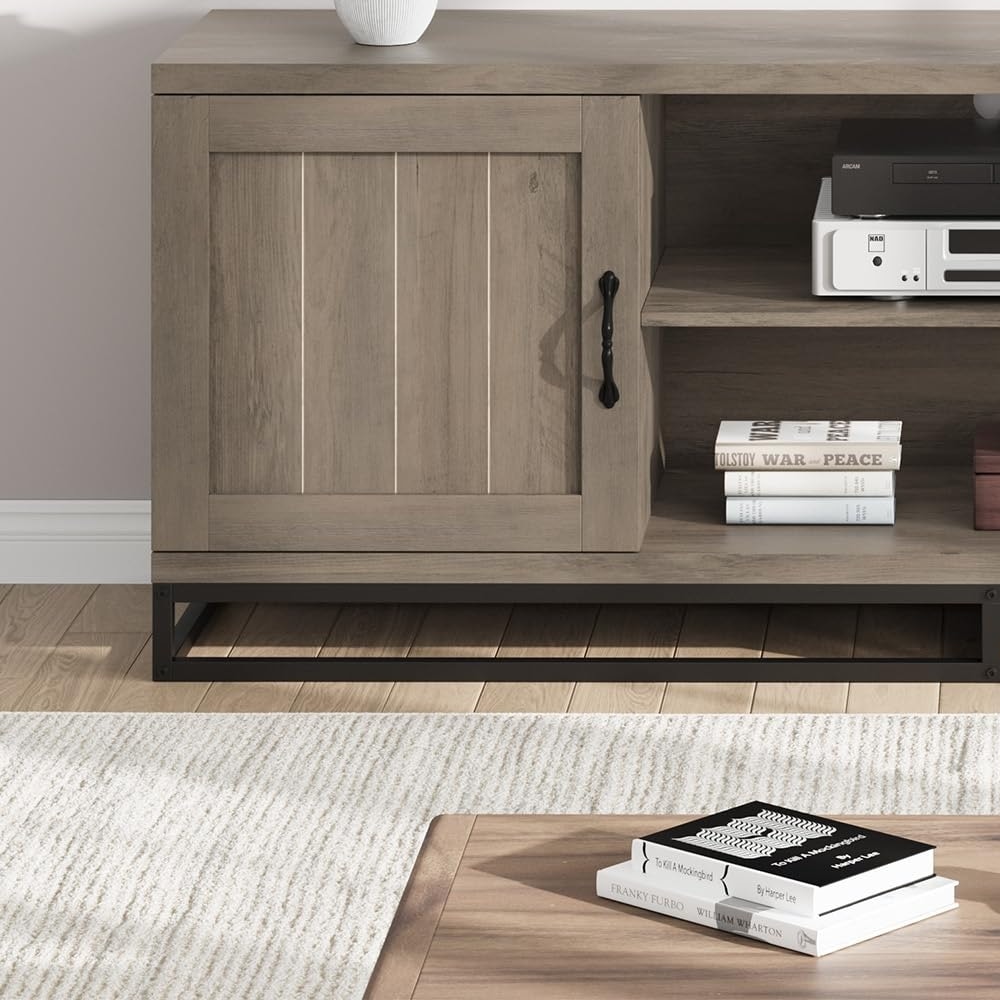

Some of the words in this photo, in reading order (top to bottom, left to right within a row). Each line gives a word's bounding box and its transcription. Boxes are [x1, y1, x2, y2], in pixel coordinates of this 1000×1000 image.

[749, 420, 781, 441] WAR
[762, 454, 807, 466] WAR
[823, 454, 883, 466] PEACE
[655, 857, 662, 868] To
[663, 860, 672, 871] Kill
[678, 863, 714, 882] Mockingbird
[611, 883, 649, 902] FRANKY
[650, 894, 685, 911] FURBO
[757, 884, 765, 896] By
[766, 887, 785, 901] Harper
[786, 890, 797, 904] Lee
[696, 906, 735, 925] WILLIAM
[736, 917, 783, 938] WHARTON
